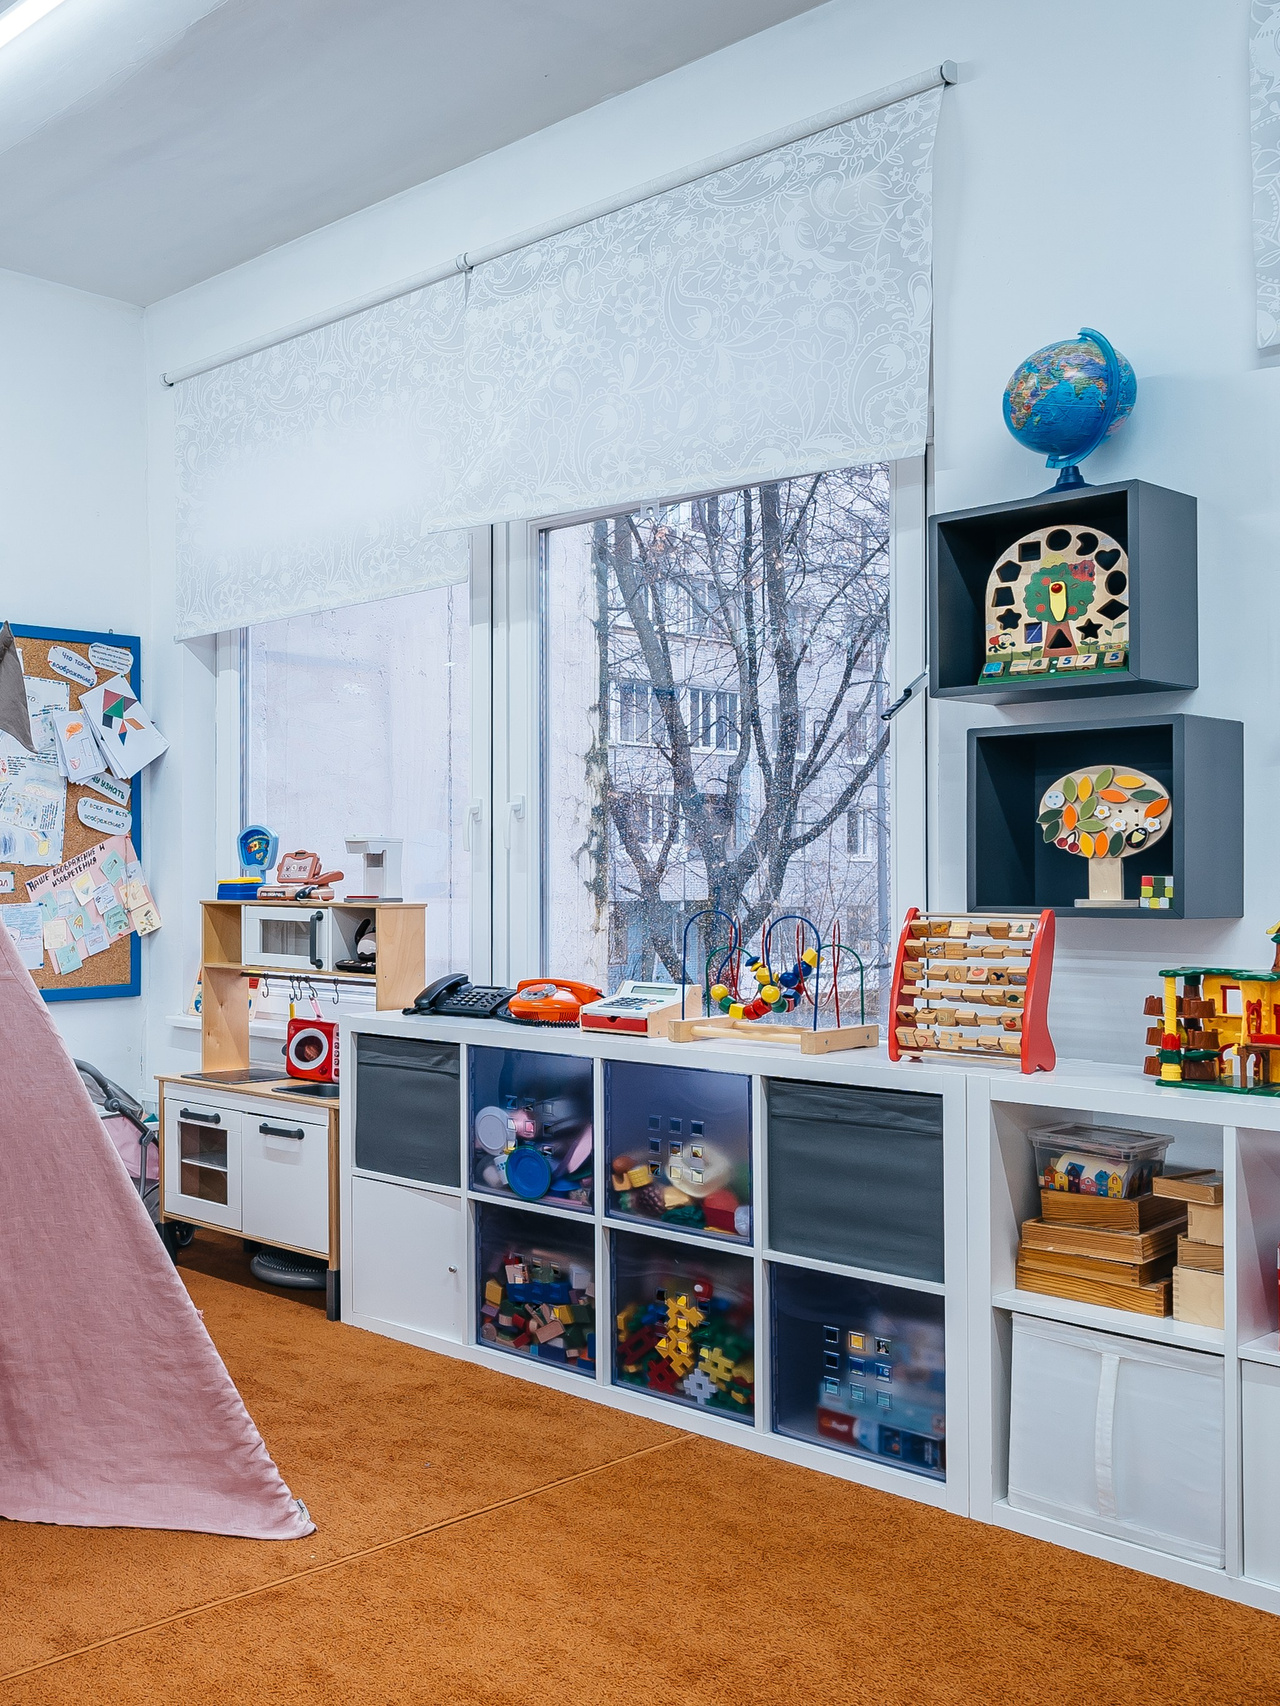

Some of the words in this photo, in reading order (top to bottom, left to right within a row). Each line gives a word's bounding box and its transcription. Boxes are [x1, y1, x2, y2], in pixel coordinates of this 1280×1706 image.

[1062, 656, 1073, 666] 5
[1081, 655, 1092, 664] 7
[1110, 651, 1120, 661] 5
[919, 1034, 932, 1047] 2
